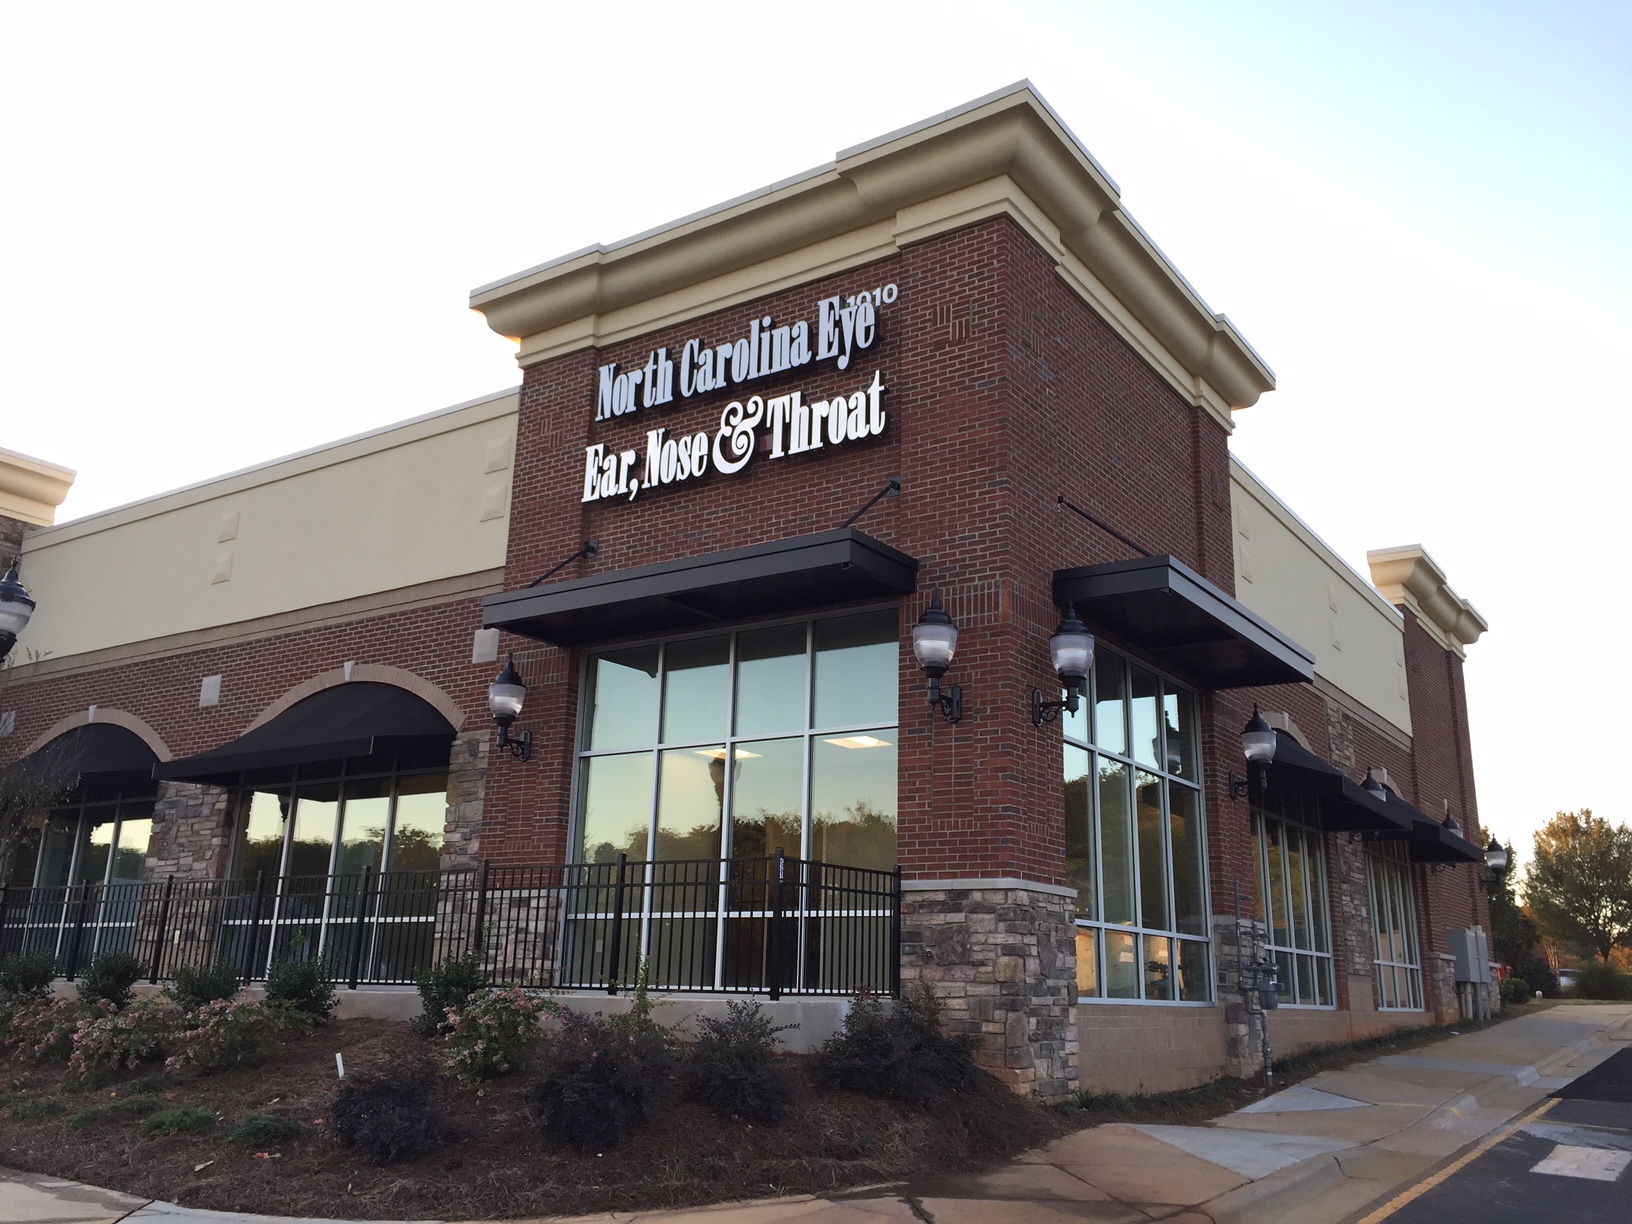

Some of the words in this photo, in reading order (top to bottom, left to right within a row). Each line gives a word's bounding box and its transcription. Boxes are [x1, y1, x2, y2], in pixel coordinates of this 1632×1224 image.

[595, 346, 674, 422] North
[680, 316, 811, 397] Carolina
[815, 295, 875, 370] Eye
[581, 443, 640, 502] Ear,
[641, 427, 709, 489] Nose
[712, 396, 763, 474] &
[766, 369, 886, 459] Throat
